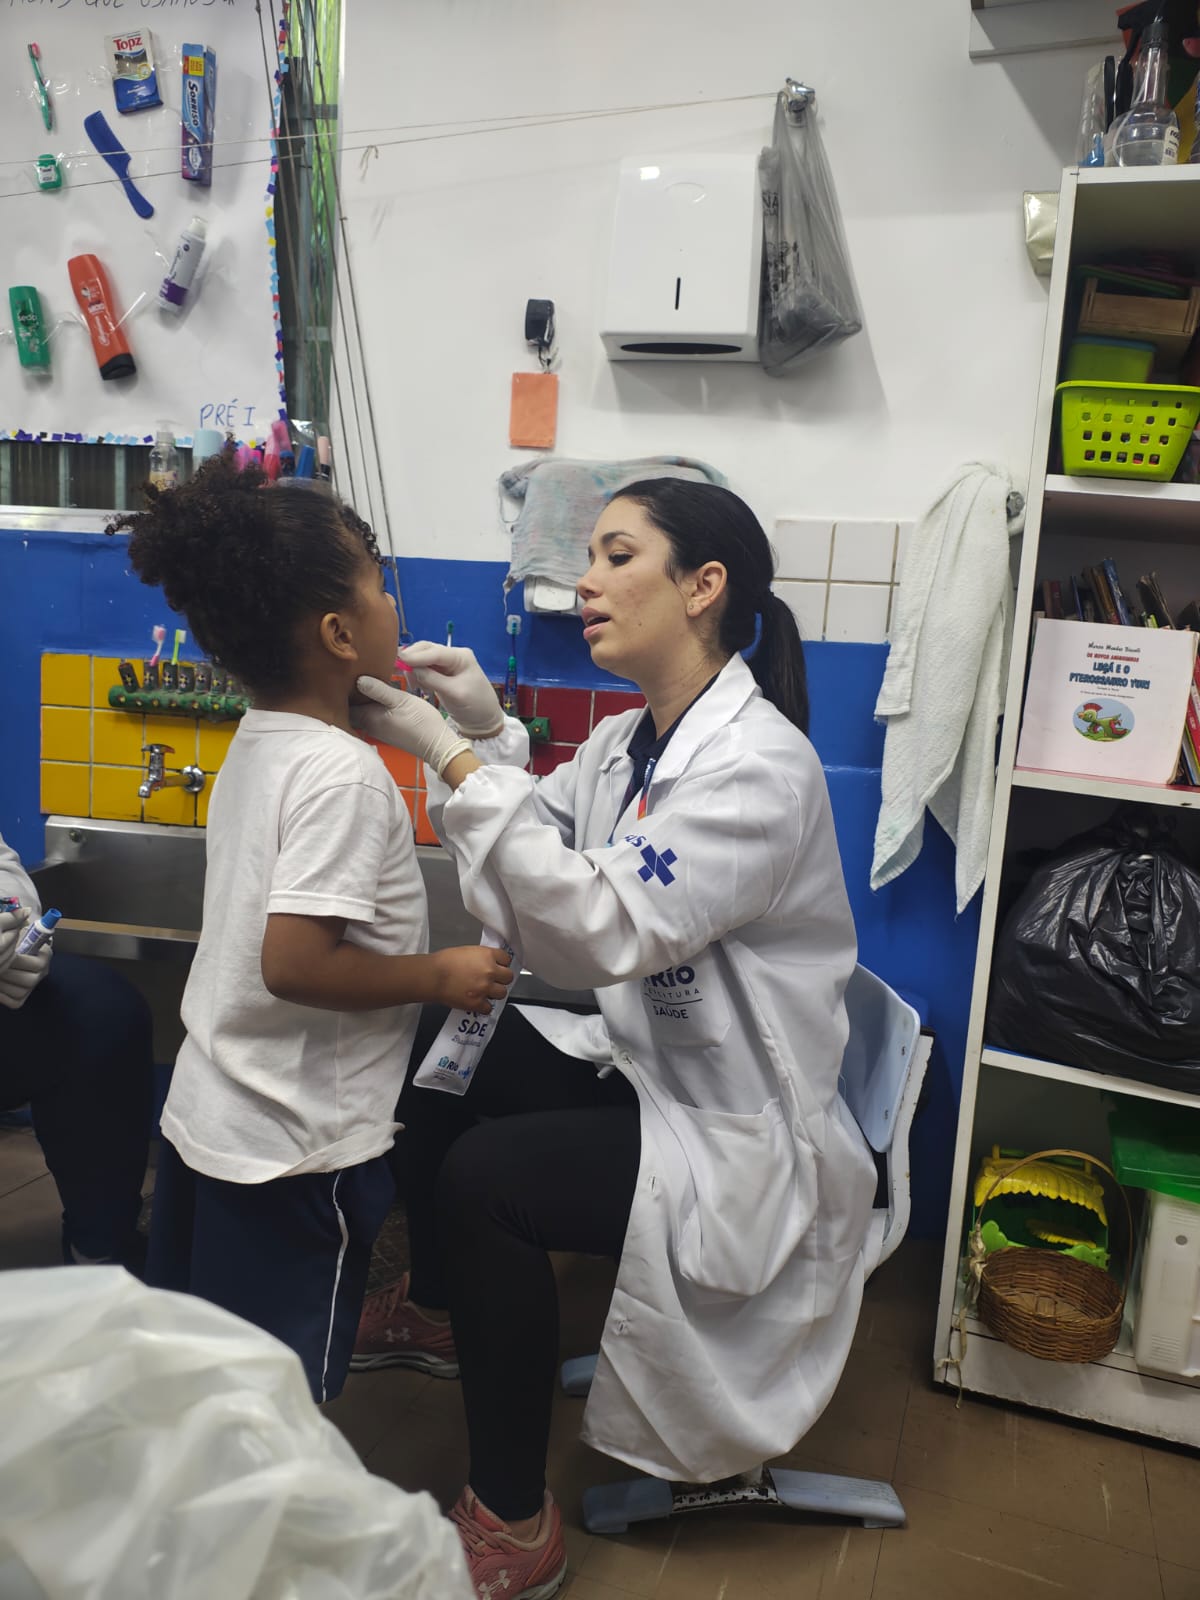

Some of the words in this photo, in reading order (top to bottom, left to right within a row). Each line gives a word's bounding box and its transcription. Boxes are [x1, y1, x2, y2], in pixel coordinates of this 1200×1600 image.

[112, 36, 143, 51] Topz
[199, 398, 238, 428] PRÉ
[243, 406, 257, 426] I
[1116, 664, 1122, 673] E
[1123, 665, 1131, 675] O
